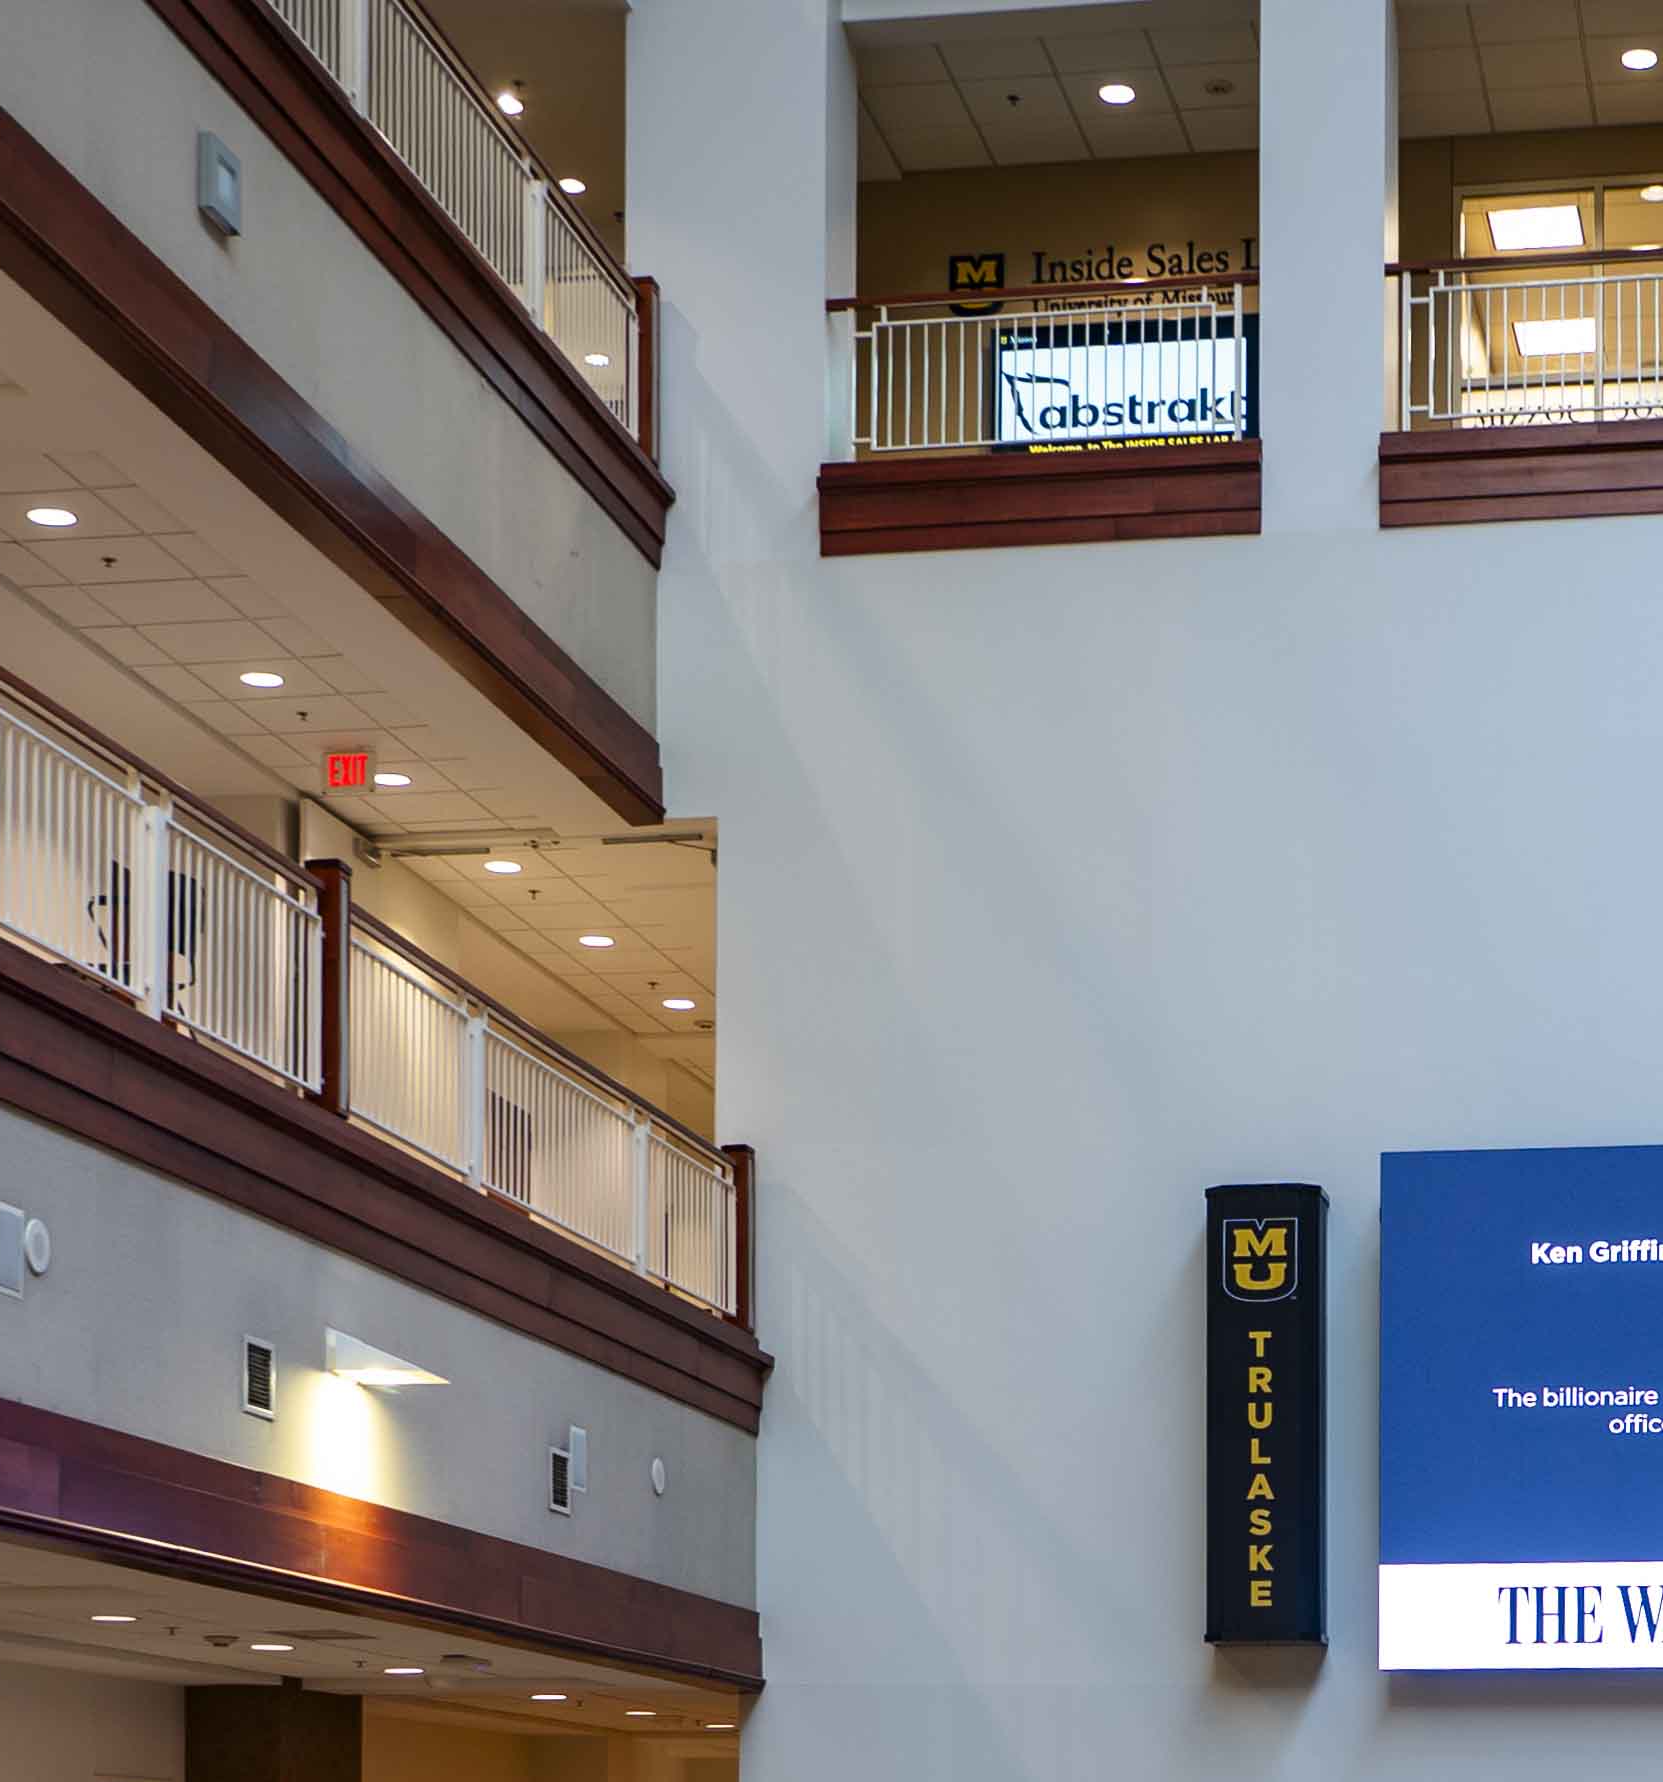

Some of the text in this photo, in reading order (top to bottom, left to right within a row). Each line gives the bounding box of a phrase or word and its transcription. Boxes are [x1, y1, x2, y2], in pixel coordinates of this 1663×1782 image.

[1032, 245, 1134, 284] Inside
[1146, 240, 1230, 278] Sales
[328, 754, 369, 787] EXIT
[1531, 1242, 1583, 1265] Ken
[1492, 1387, 1537, 1408] The
[1542, 1386, 1659, 1407] billionaire
[1247, 1331, 1275, 1607] TRULASKE
[1498, 1585, 1603, 1645] THE
